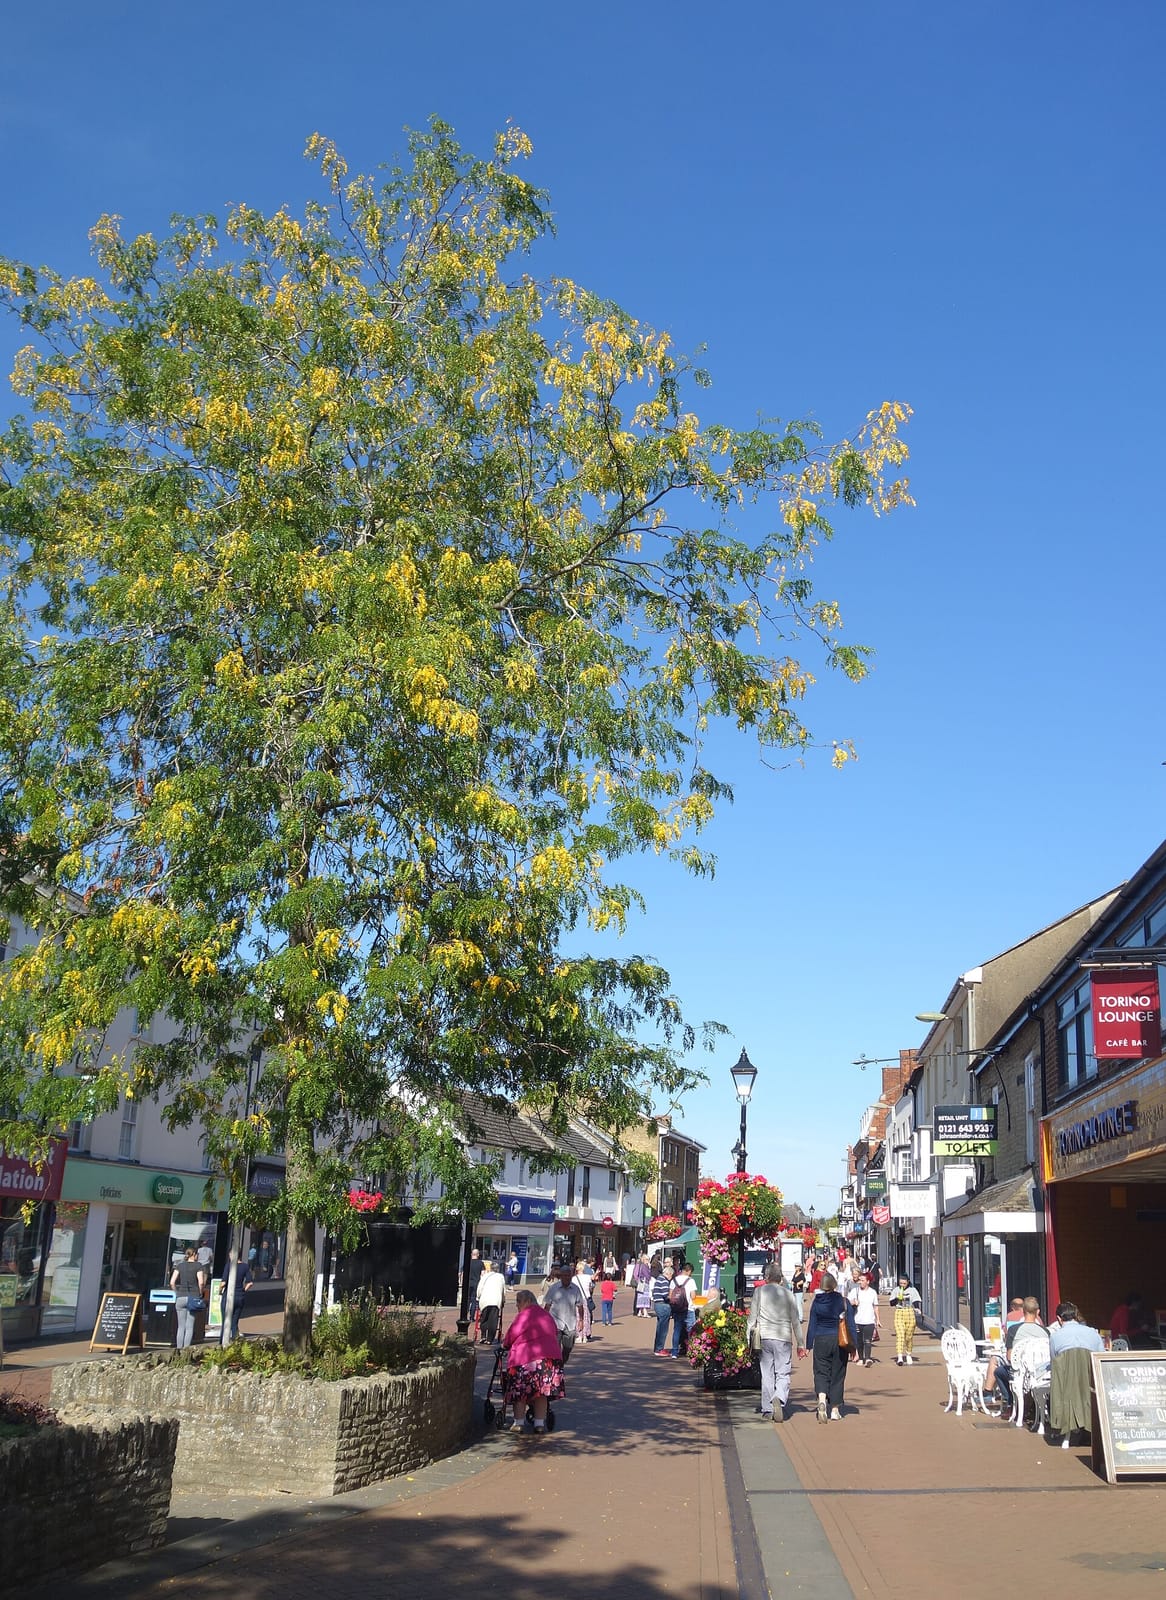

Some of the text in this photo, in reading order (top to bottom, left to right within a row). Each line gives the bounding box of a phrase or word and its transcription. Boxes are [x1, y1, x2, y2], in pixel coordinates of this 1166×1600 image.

[1099, 996, 1151, 1008] TORINO
[1098, 1011, 1154, 1023] LOUNGE
[938, 1124, 957, 1133] 0121
[958, 1124, 974, 1133] 643
[945, 1143, 987, 1153] TO LET
[1120, 1366, 1166, 1377] TORINO
